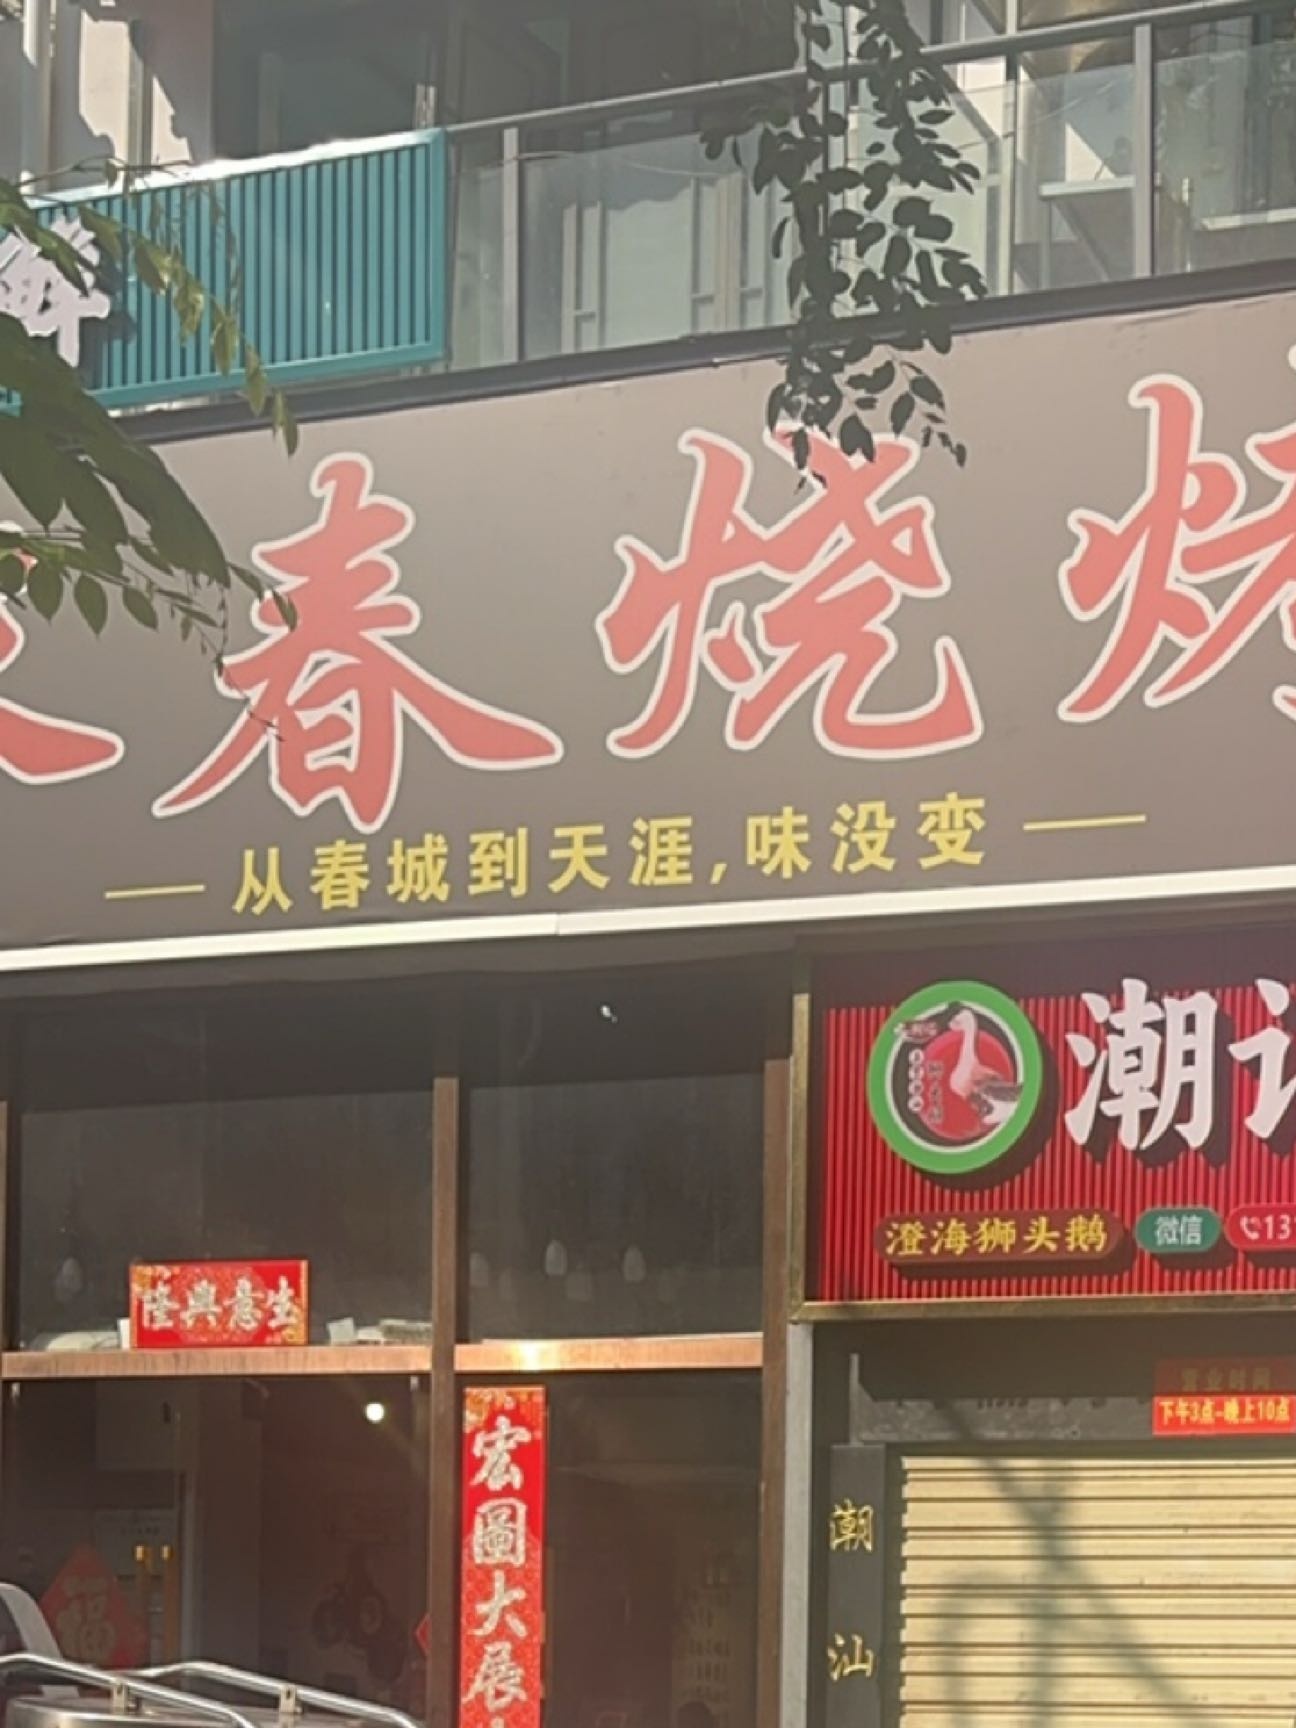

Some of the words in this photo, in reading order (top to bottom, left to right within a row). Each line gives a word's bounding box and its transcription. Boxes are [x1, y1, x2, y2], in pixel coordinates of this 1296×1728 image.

[883, 1212, 1109, 1256] 澄海狮头鹅
[1153, 1214, 1204, 1247] 微信
